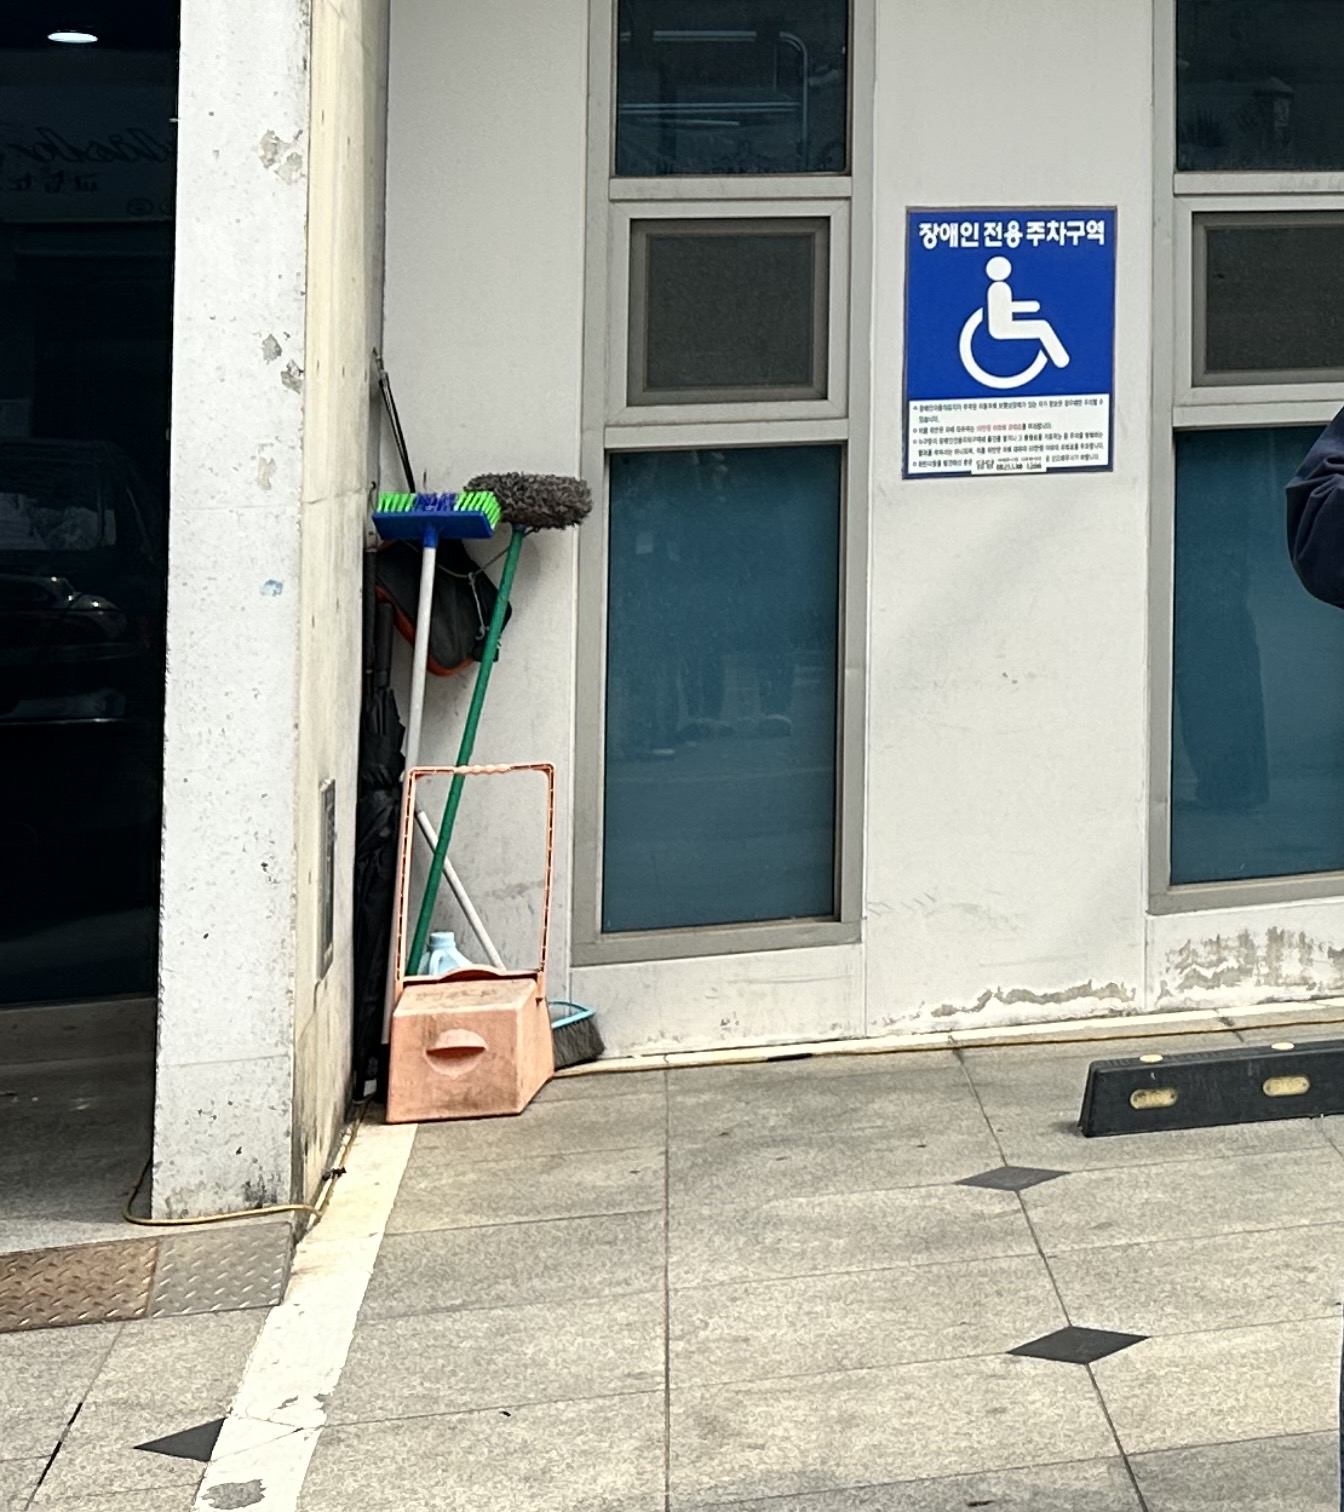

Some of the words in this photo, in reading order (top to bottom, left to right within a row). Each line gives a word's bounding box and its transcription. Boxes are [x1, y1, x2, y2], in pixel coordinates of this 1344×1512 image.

[919, 222, 979, 249] 장애인
[984, 220, 1022, 248] 전용
[1026, 220, 1105, 247] 주차구역
